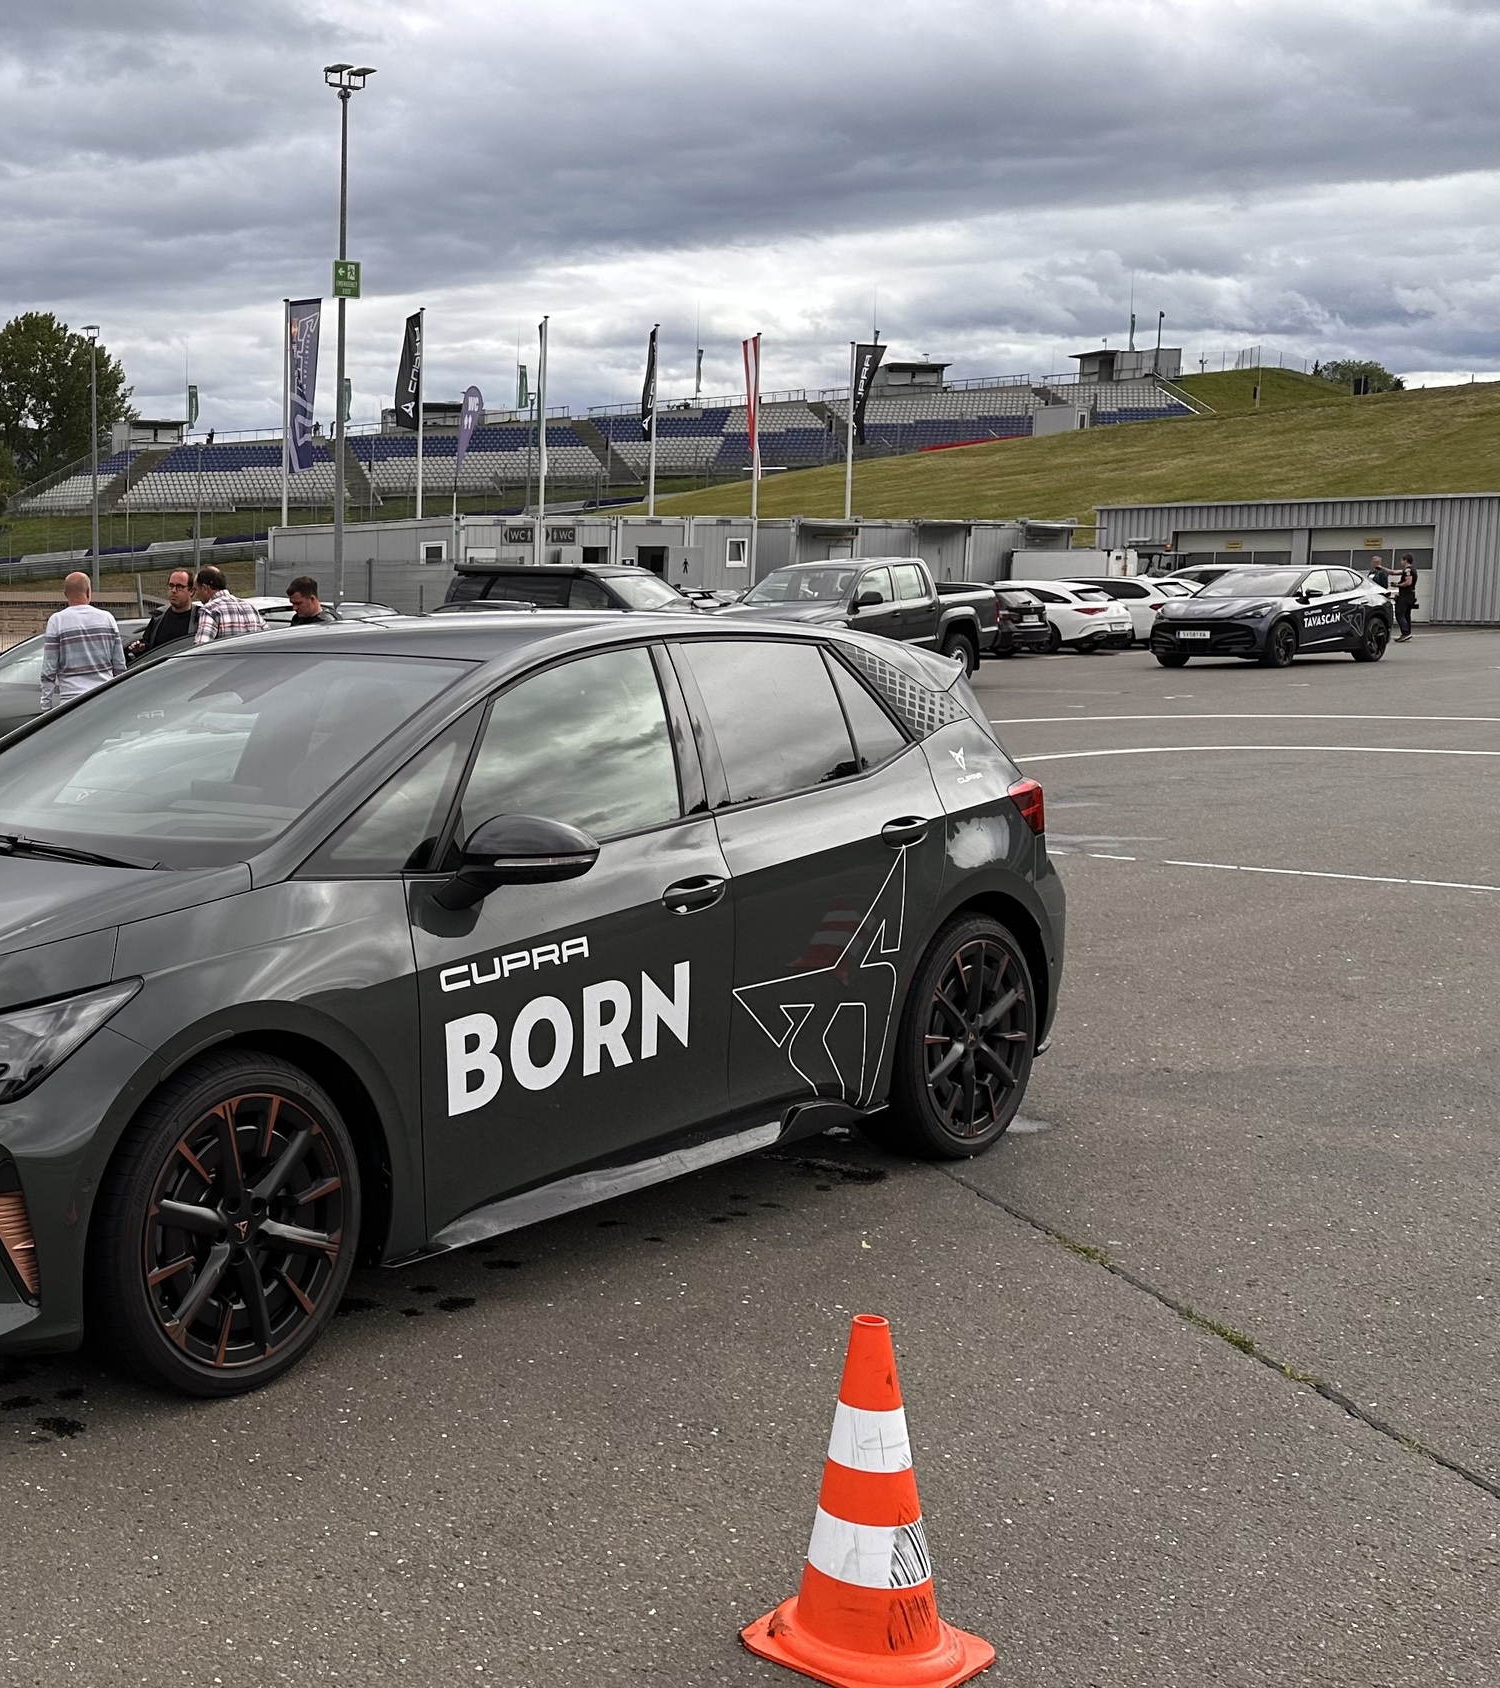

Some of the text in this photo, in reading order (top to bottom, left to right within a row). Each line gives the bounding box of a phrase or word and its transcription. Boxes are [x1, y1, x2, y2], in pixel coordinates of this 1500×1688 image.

[468, 396, 479, 411] WC
[510, 530, 526, 540] WC
[559, 530, 574, 540] WC
[1303, 612, 1341, 628] TAVASCAN
[956, 772, 984, 784] CUPRA
[439, 936, 590, 993] CUPRA
[445, 961, 691, 1117] BORN
